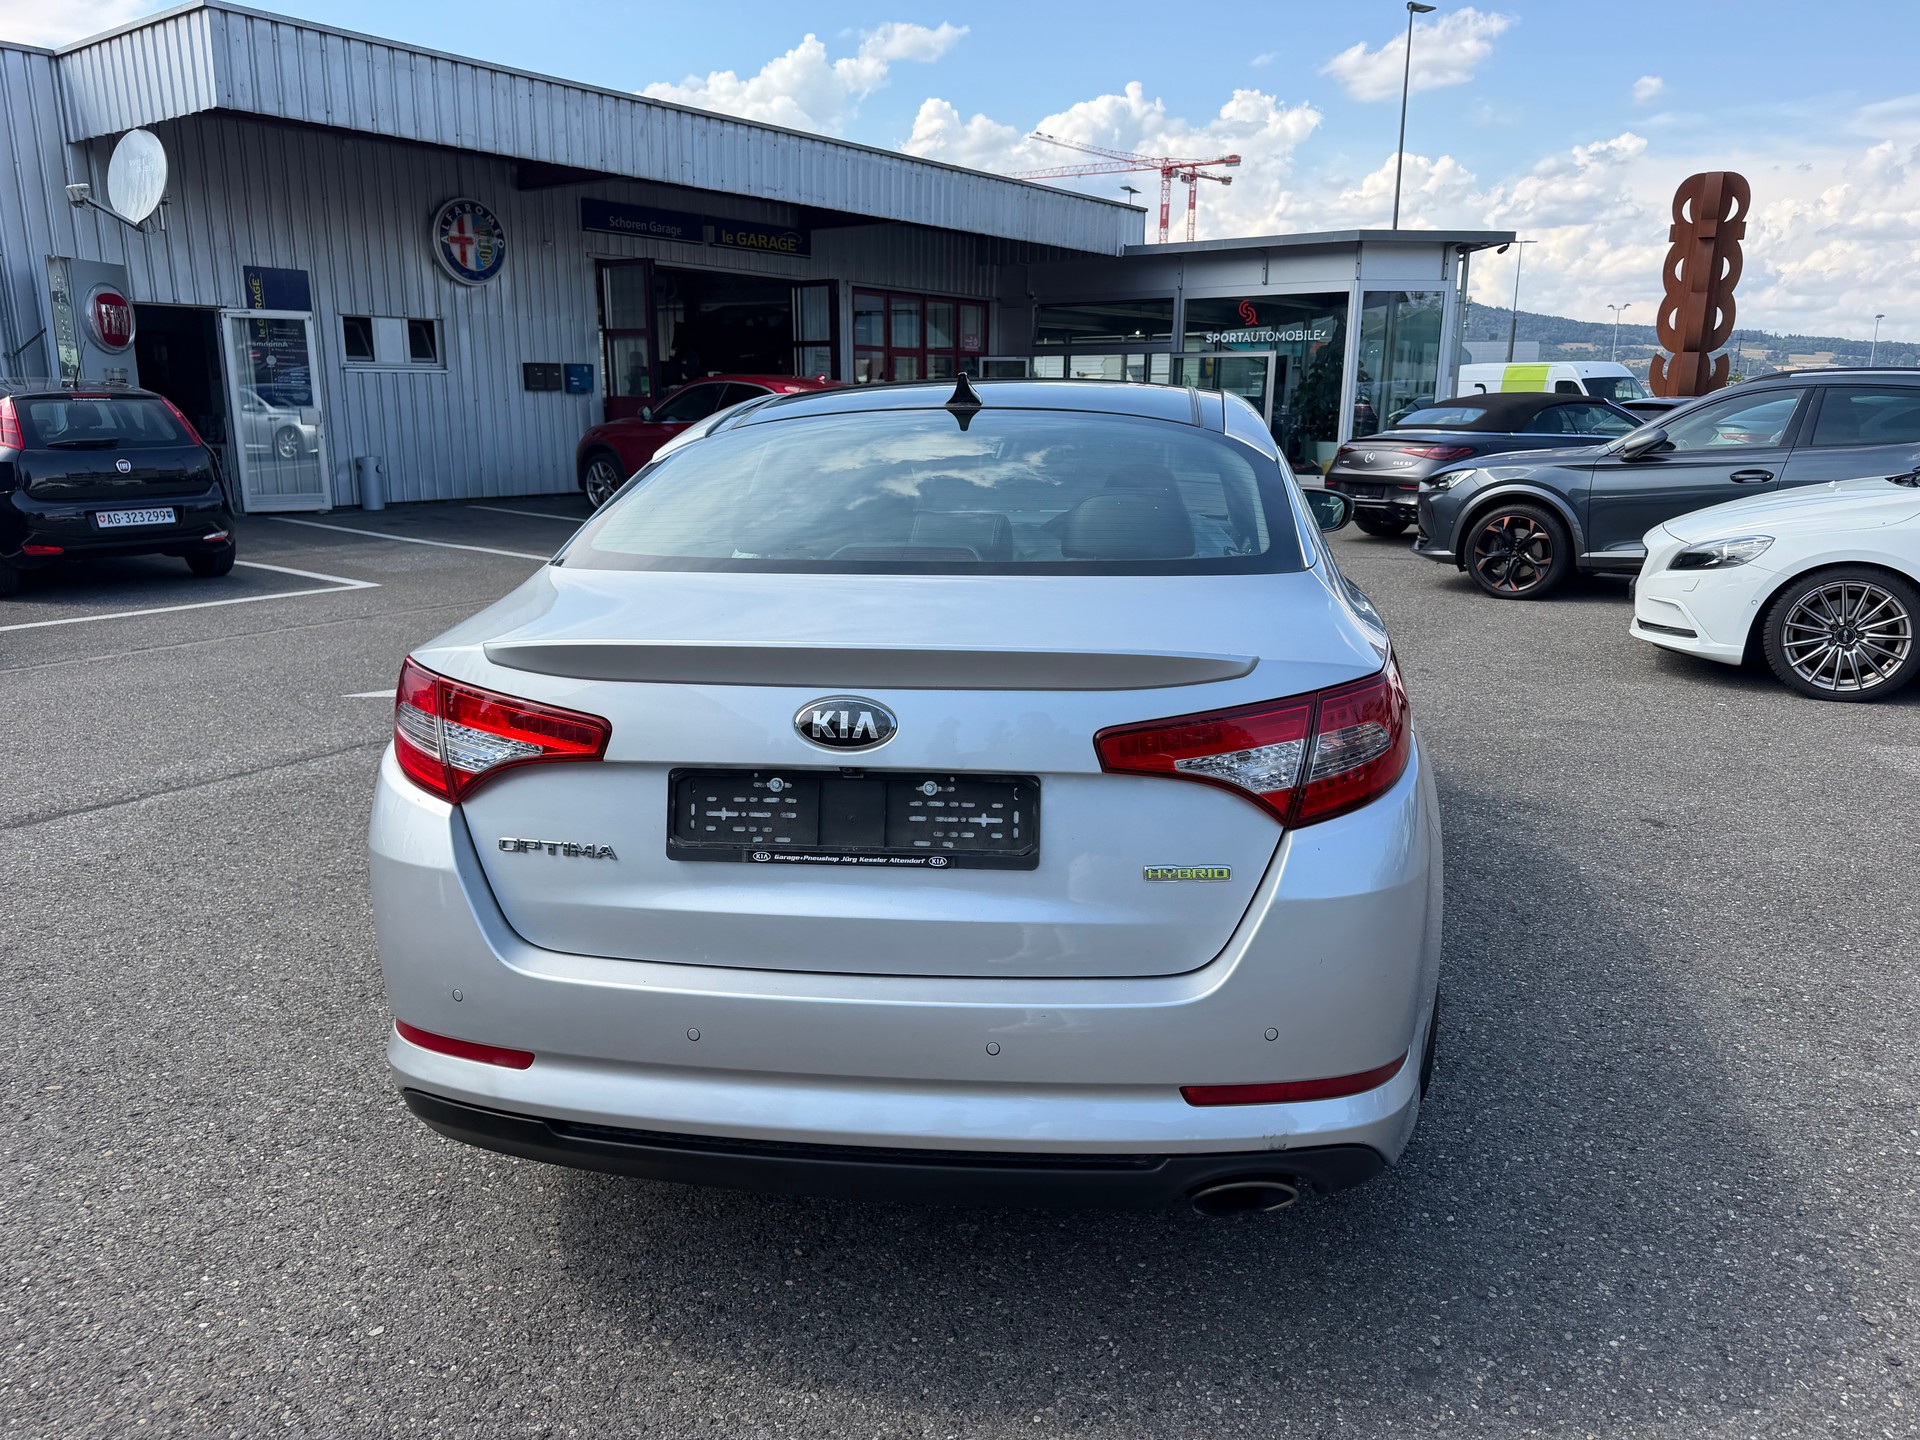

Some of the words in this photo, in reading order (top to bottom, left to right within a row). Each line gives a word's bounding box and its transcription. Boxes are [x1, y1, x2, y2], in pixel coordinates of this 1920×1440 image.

[441, 206, 463, 244] ALFA
[464, 203, 505, 249] ROMEO
[609, 215, 647, 231] Schoren
[649, 221, 682, 237] Garage
[722, 229, 734, 244] le
[736, 231, 797, 252] GARAGE
[252, 278, 265, 327] GRAGE
[100, 303, 129, 336] FIAT
[1205, 329, 1321, 344] SPORTAUTOMOBILE
[812, 710, 879, 739] KIA
[498, 836, 618, 861] OPTIMA
[773, 854, 840, 863] Garage+Pneushop
[840, 855, 858, 863] Jürg
[1146, 868, 1230, 879] HYBRID
